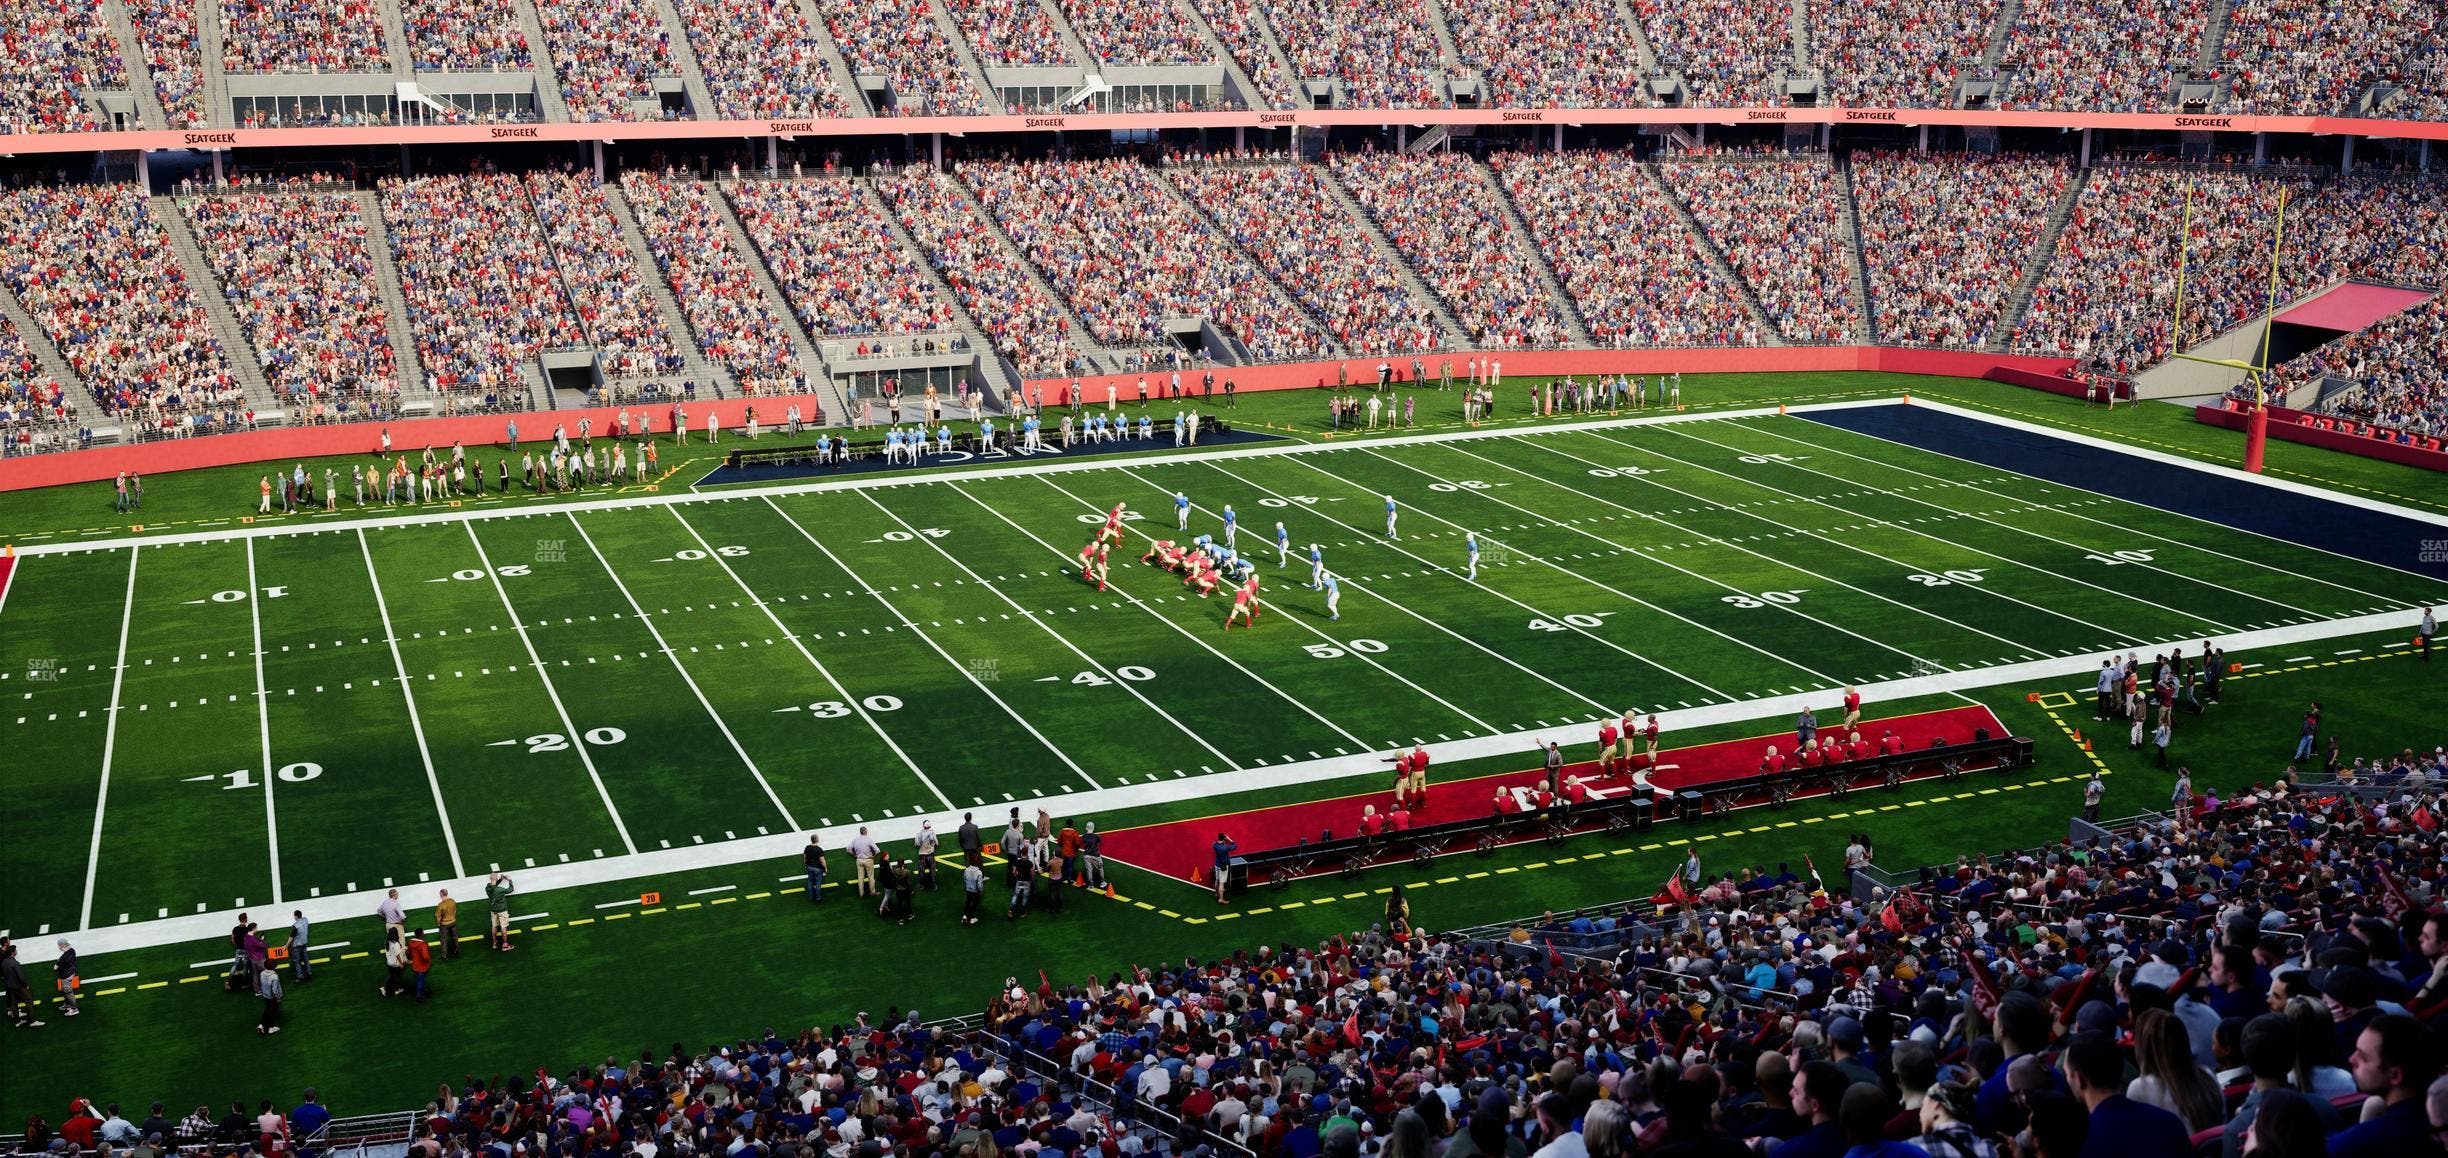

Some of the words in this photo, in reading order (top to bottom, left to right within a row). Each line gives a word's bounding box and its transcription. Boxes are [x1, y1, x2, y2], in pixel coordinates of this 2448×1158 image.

[1260, 114, 1296, 123] SEATGEEK
[1502, 112, 1542, 121] SEATGEEK
[1747, 111, 1787, 120] SEATGEEK
[1846, 111, 1896, 121] SEATGEEK
[770, 123, 813, 133] SEATGEEK
[1025, 118, 1065, 128] SEATGEEK
[2174, 117, 2232, 127] SEATGEEK
[185, 132, 236, 144] SEATGEEK
[491, 128, 538, 138] SEATGEEK
[675, 545, 751, 561] 30
[452, 564, 533, 581] 20
[1907, 569, 1984, 587] 20
[1721, 591, 1801, 609] 30
[1527, 613, 1604, 632] 40
[1302, 638, 1390, 659] 50
[1071, 665, 1157, 687] 40
[808, 695, 904, 718] 30
[525, 727, 627, 754] 20
[222, 762, 323, 790] 10
[646, 894, 656, 903] 20
[274, 948, 283, 957] 10
